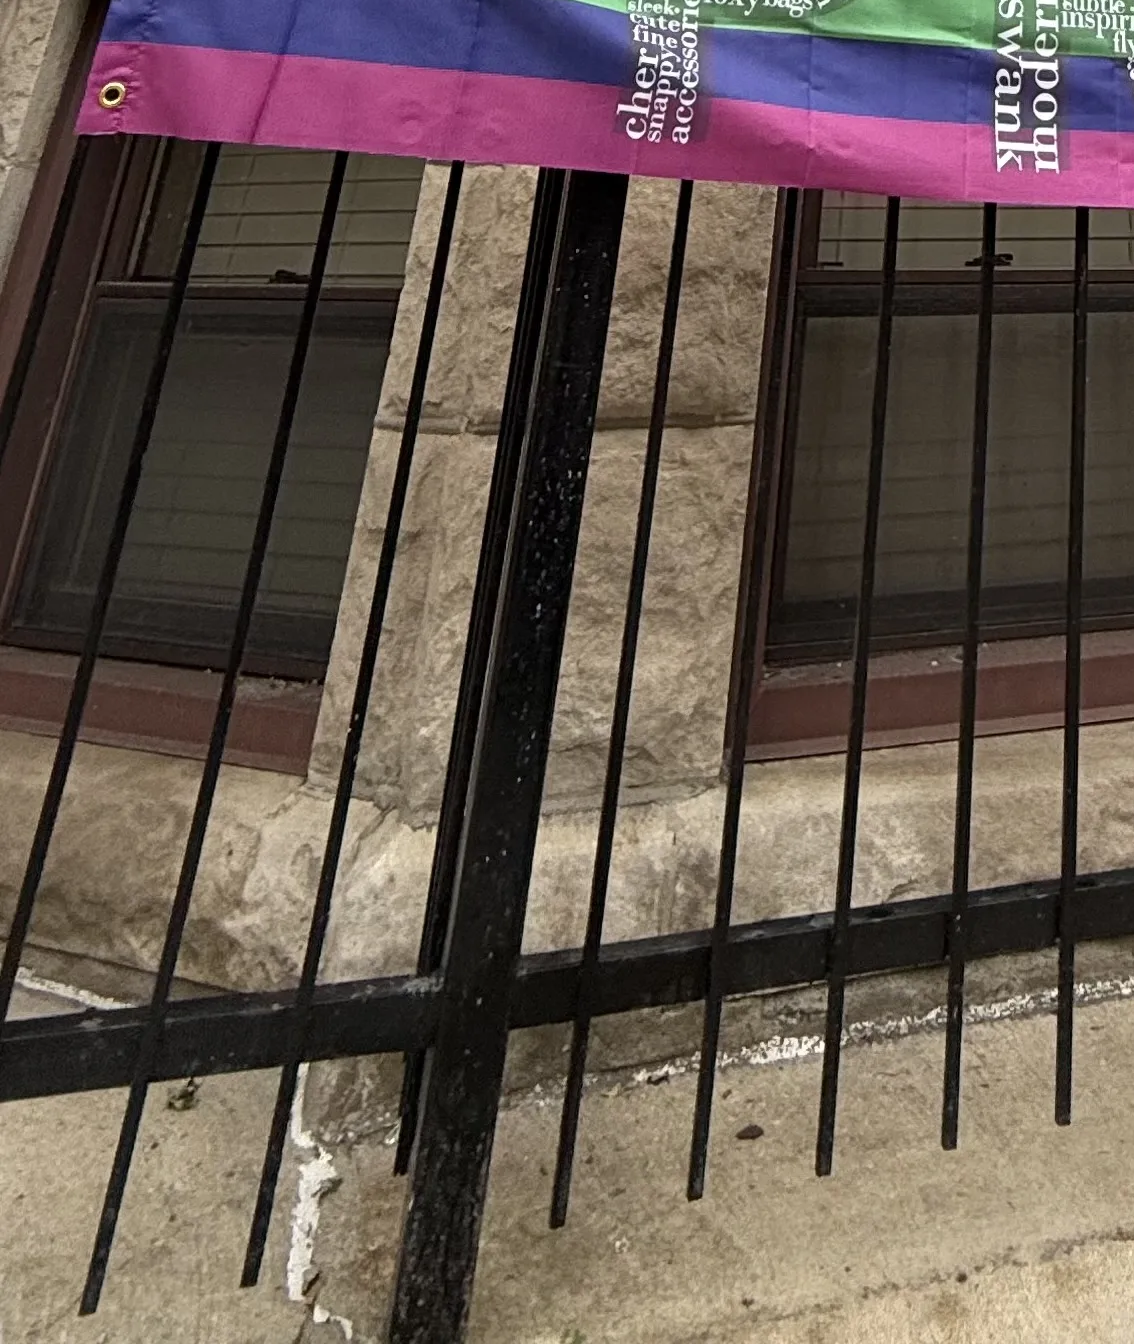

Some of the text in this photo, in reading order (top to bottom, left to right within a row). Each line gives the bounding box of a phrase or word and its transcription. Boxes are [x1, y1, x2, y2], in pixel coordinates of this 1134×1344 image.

[630, 13, 681, 33] cute
[632, 23, 678, 49] fine
[616, 47, 660, 140] cher
[647, 44, 682, 144] snappy
